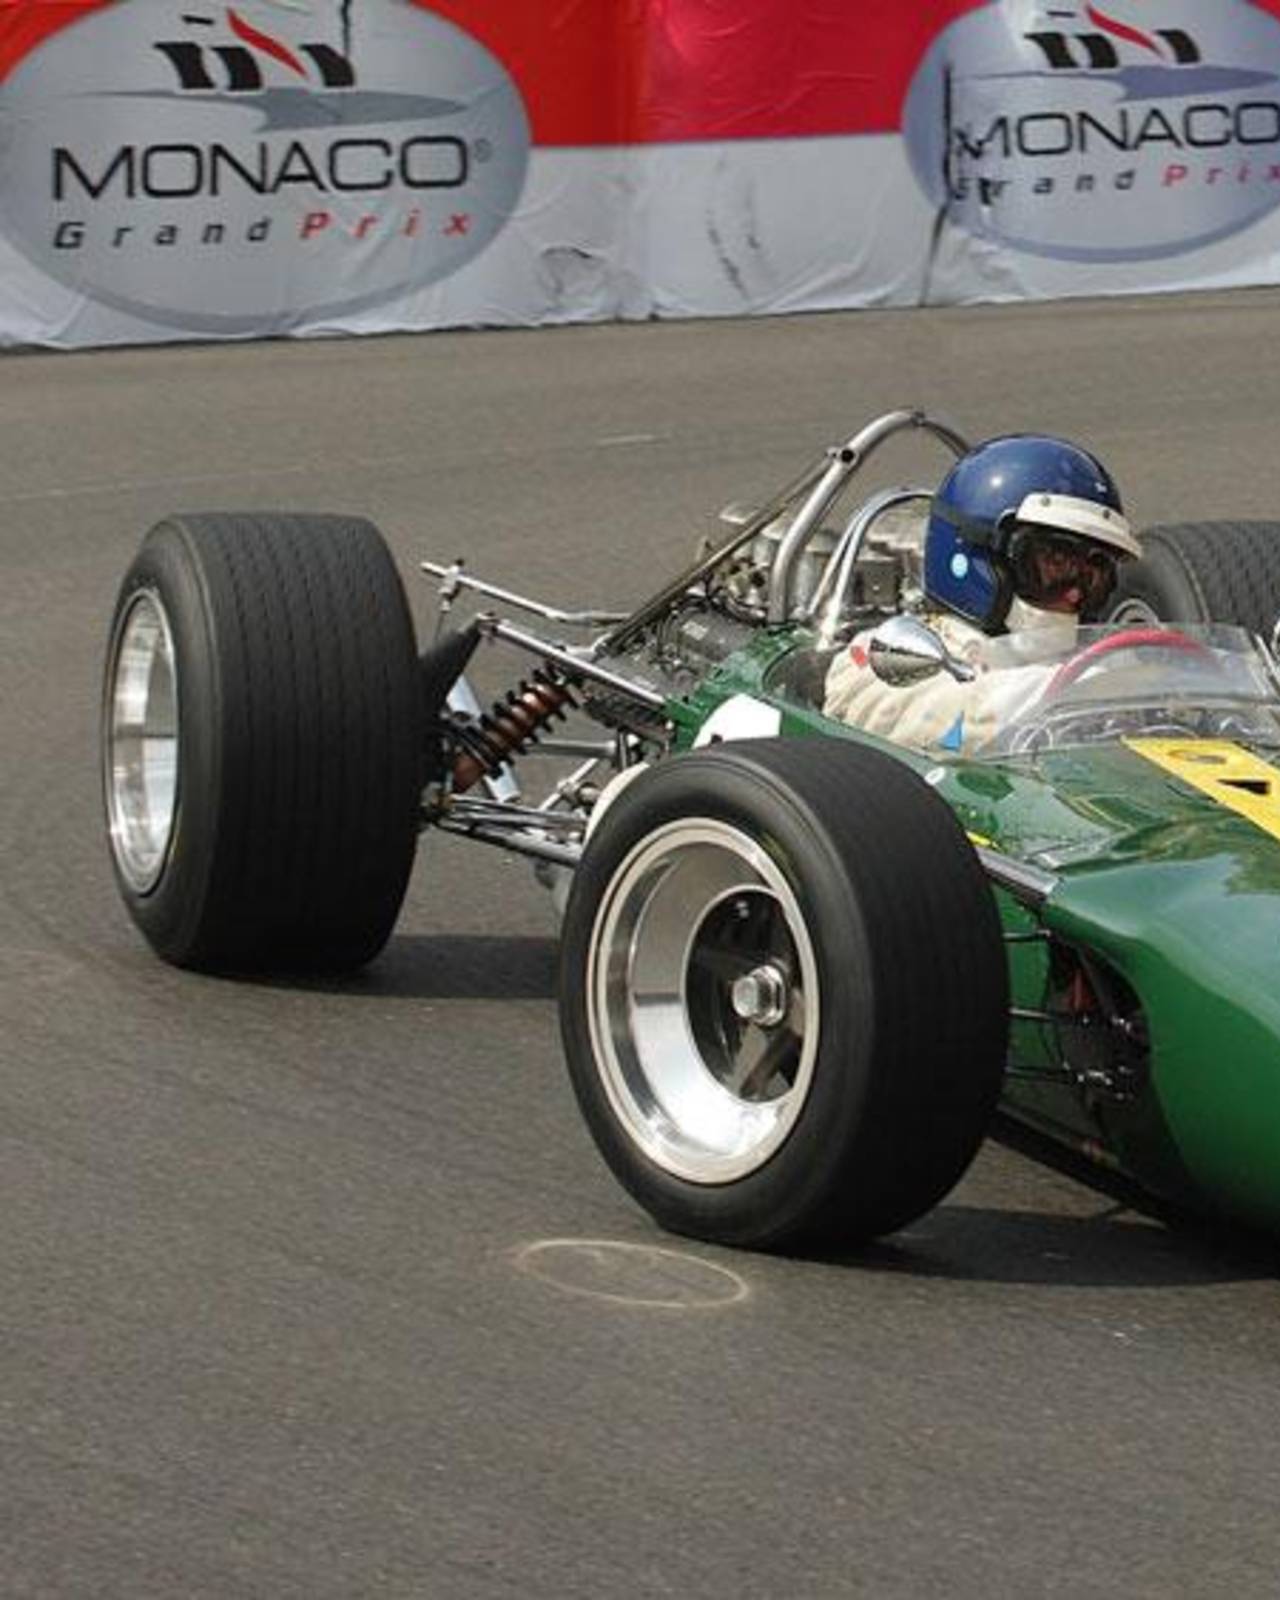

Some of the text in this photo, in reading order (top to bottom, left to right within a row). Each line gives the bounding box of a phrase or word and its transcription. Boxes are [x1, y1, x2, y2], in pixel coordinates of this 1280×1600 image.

[51, 135, 469, 200] MONACO
[53, 211, 471, 250] Grand Prix
